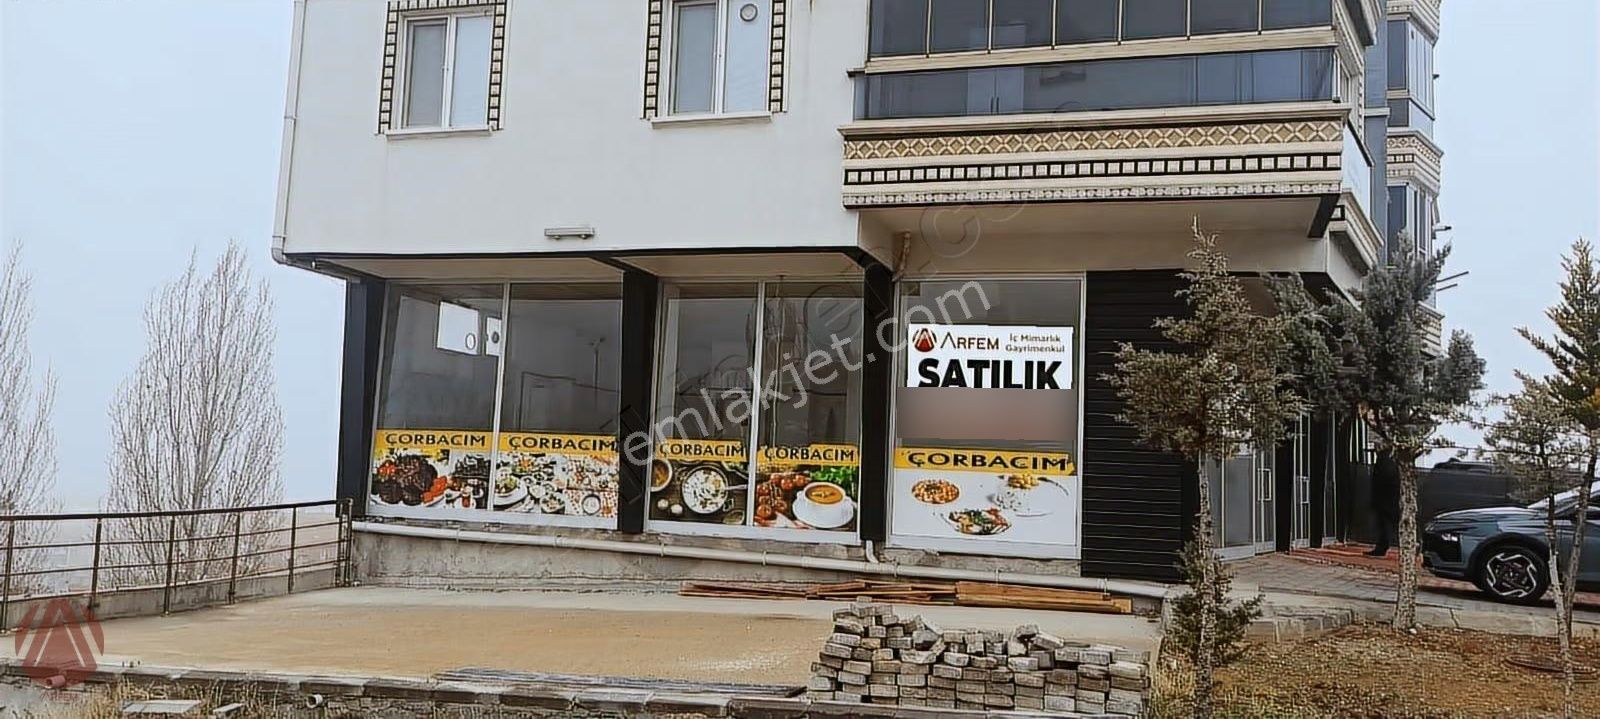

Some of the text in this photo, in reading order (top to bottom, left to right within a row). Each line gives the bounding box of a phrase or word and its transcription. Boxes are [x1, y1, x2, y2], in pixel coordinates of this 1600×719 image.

[940, 331, 1000, 350] ARFEM
[1005, 344, 1065, 353] Gayrimenkul
[918, 357, 1062, 390] SATILIK
[386, 433, 486, 447] ÇORBACIM
[508, 436, 617, 451] ÇORBACIM
[659, 443, 744, 457] ÇORBACIM
[765, 448, 854, 462] ÇORBACIM
[907, 453, 1067, 471] ÇORBACIM
